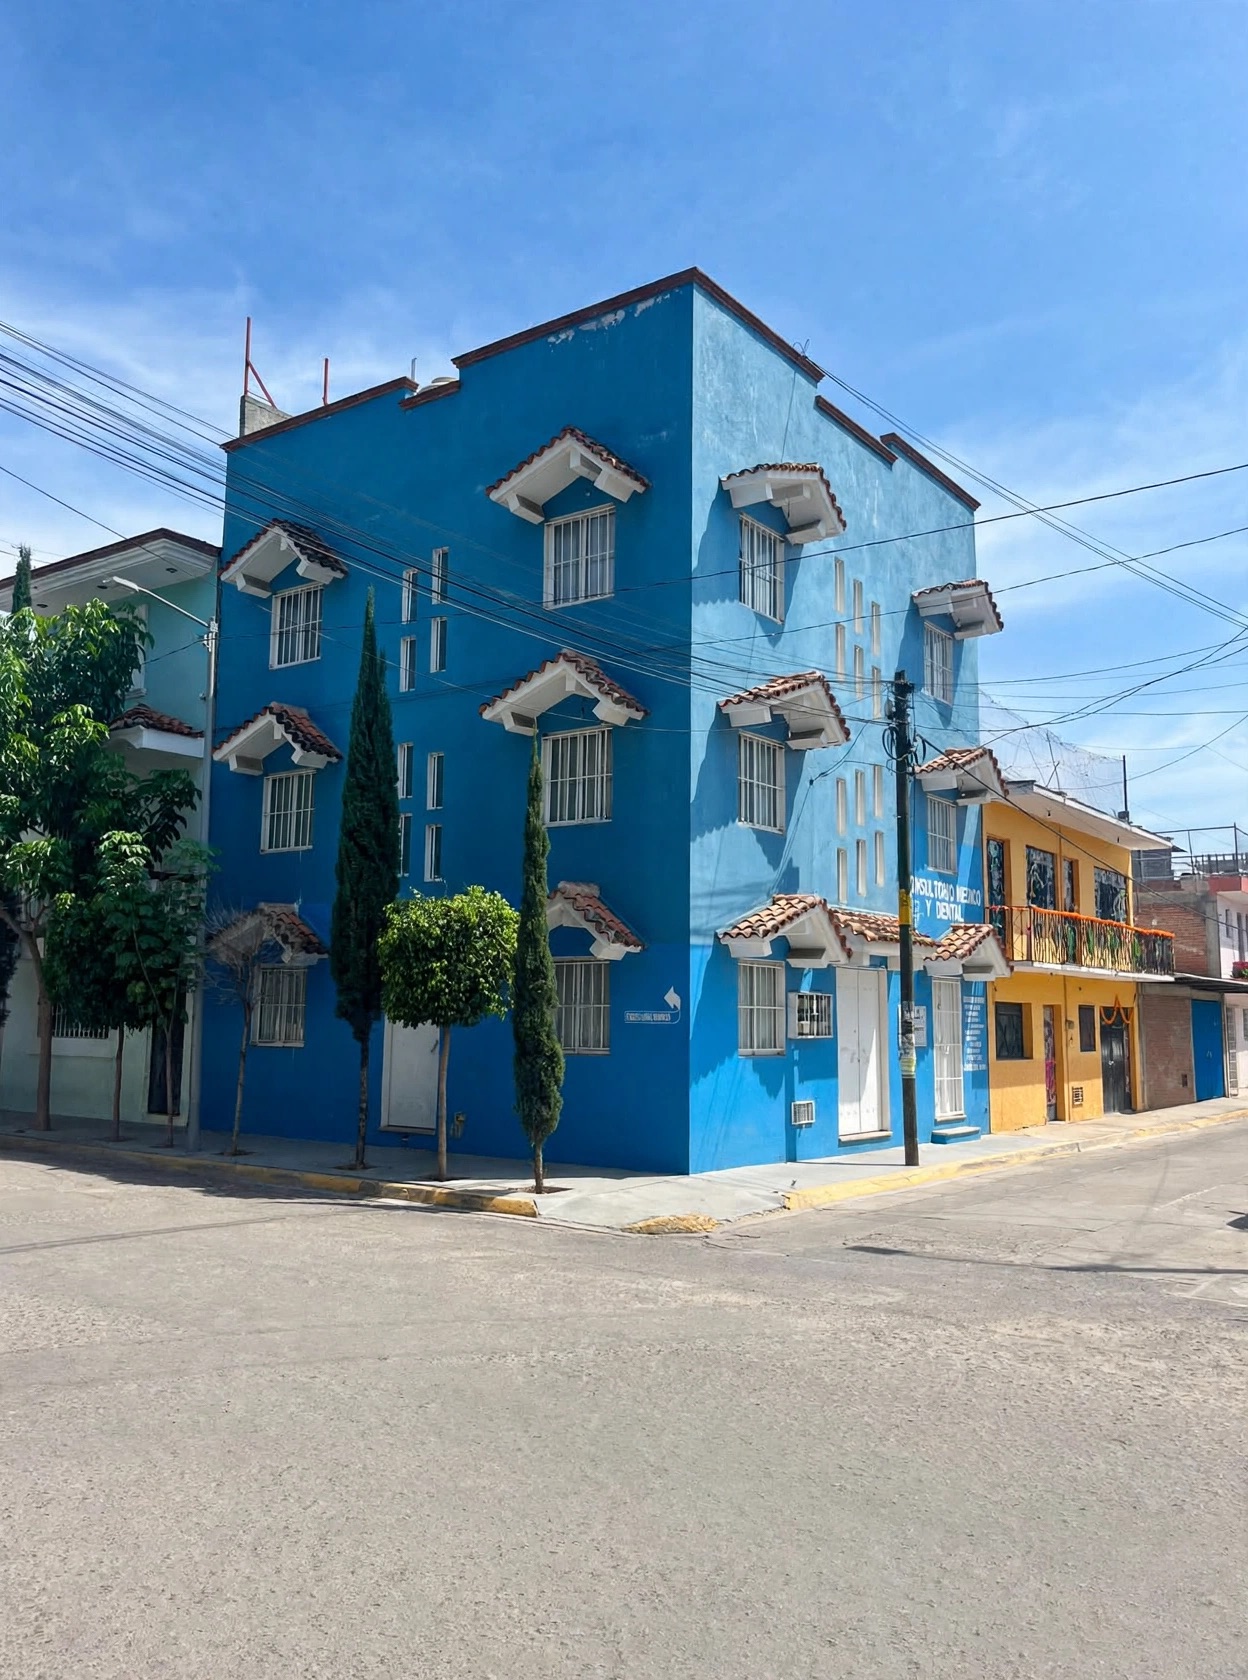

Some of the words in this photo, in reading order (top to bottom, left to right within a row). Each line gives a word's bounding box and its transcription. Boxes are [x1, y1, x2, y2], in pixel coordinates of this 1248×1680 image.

[910, 875, 955, 902] ONSULTORIO
[925, 899, 932, 918] Y
[936, 901, 965, 922] DENTAL
